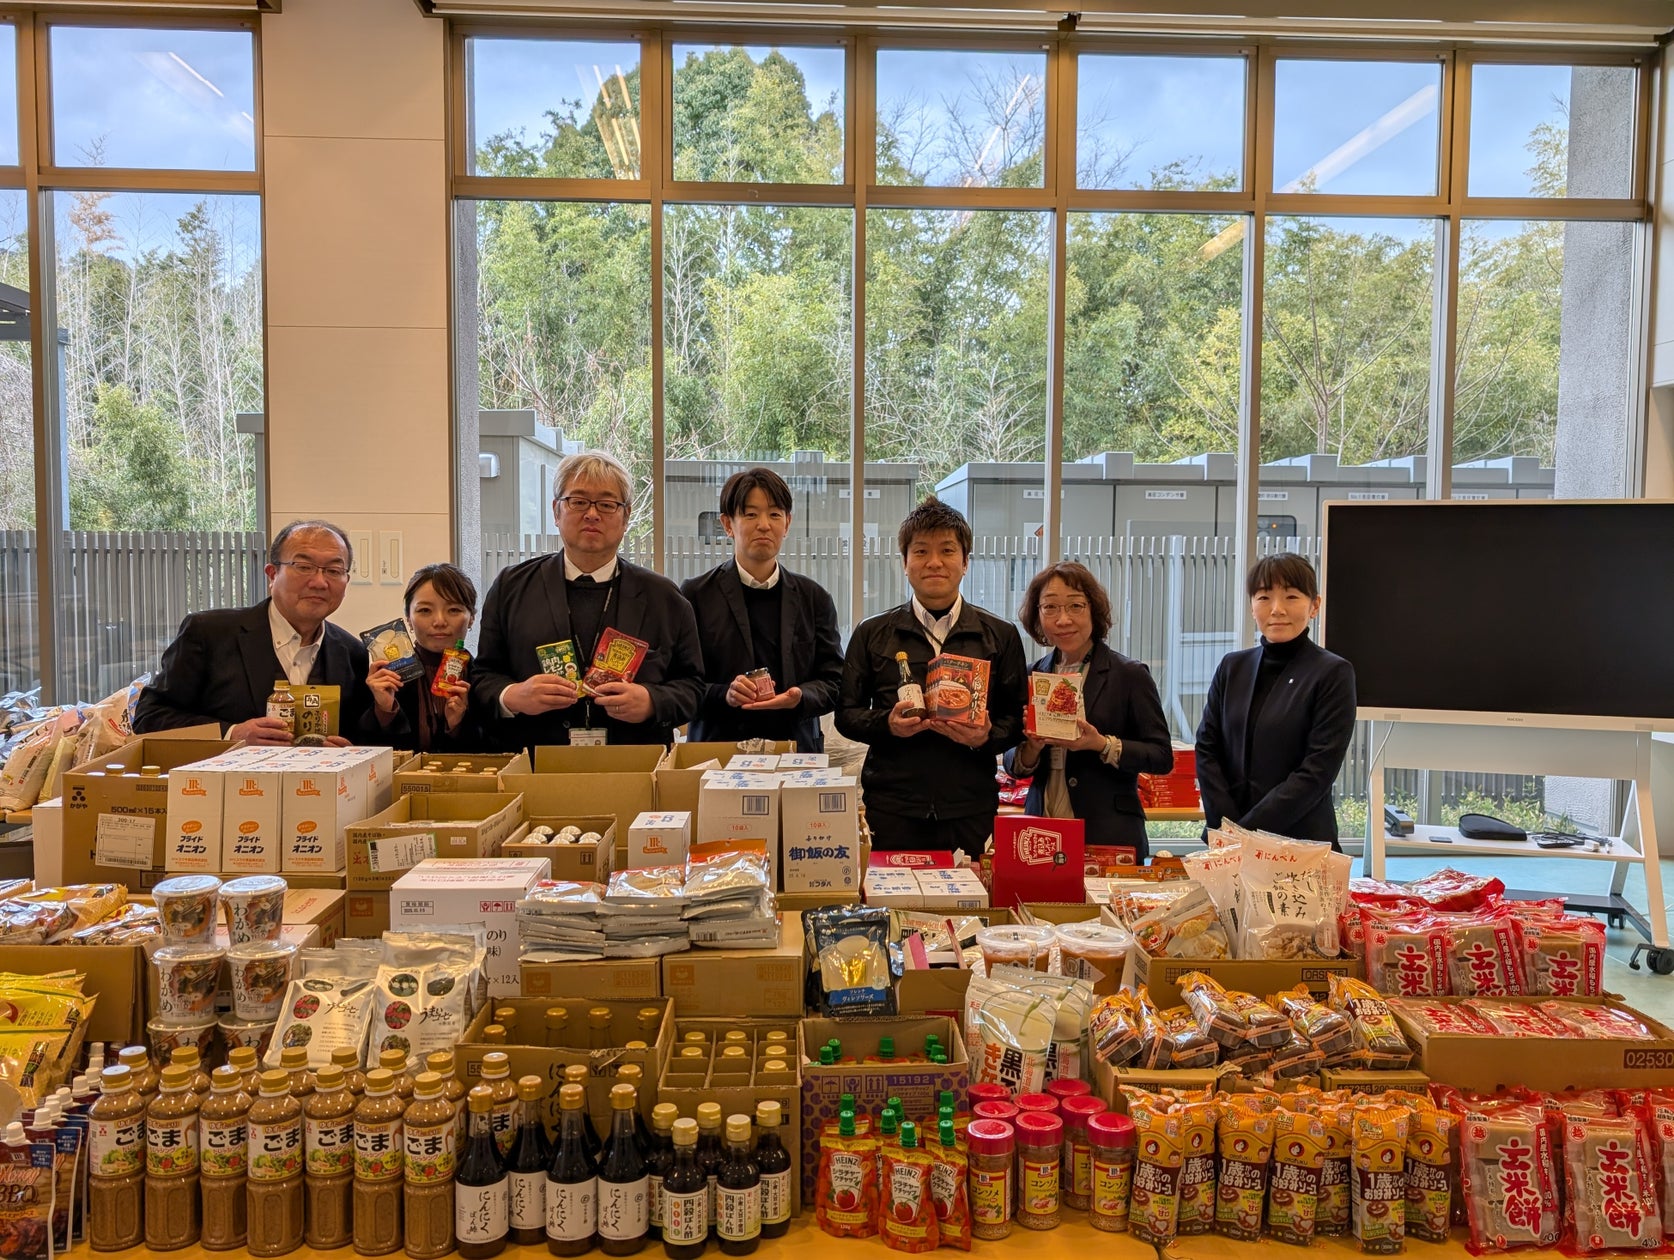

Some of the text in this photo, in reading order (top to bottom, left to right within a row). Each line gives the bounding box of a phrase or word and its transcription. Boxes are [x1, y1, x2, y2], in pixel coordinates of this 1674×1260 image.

[302, 710, 313, 732] のり
[176, 845, 207, 854] オニオン
[233, 845, 264, 854] オニオン
[292, 845, 322, 854] オニオン
[789, 845, 850, 861] 御飯の友
[1264, 853, 1298, 862] にんべん
[234, 903, 250, 943] わかめ
[486, 930, 507, 941] のり
[161, 968, 173, 1012] わかめ
[235, 967, 247, 1003] わかめ
[893, 1075, 930, 1085] 15192
[148, 1128, 181, 1147] ごま
[208, 1126, 246, 1148] ごま
[264, 1127, 300, 1152] ごま
[318, 1123, 354, 1147] ごま
[356, 1133, 389, 1151] ごま
[407, 1136, 443, 1155] ごま
[835, 1156, 859, 1166] HEINZ
[1221, 1158, 1260, 1179] 1歳からの
[1406, 1158, 1445, 1180] 1歳からの
[832, 1168, 861, 1176] シラチャー
[834, 1175, 859, 1183] ケチャップ
[895, 1168, 918, 1179] HEINZ
[1275, 1162, 1316, 1183] 1歳からの
[971, 1187, 1000, 1197] コンソメ
[1031, 1180, 1058, 1188] コンソメ
[1100, 1180, 1129, 1190] コンソメ
[1498, 1138, 1542, 1236] 玄米餅
[1597, 1141, 1642, 1238] 玄米餅
[514, 1178, 526, 1221] にんにく
[1364, 1188, 1404, 1200] お好みソー
[479, 1190, 491, 1234] にんにく
[556, 1188, 567, 1233] にんにく
[610, 1188, 622, 1232] にんにく
[724, 1194, 735, 1235] 四穀ぽん酢
